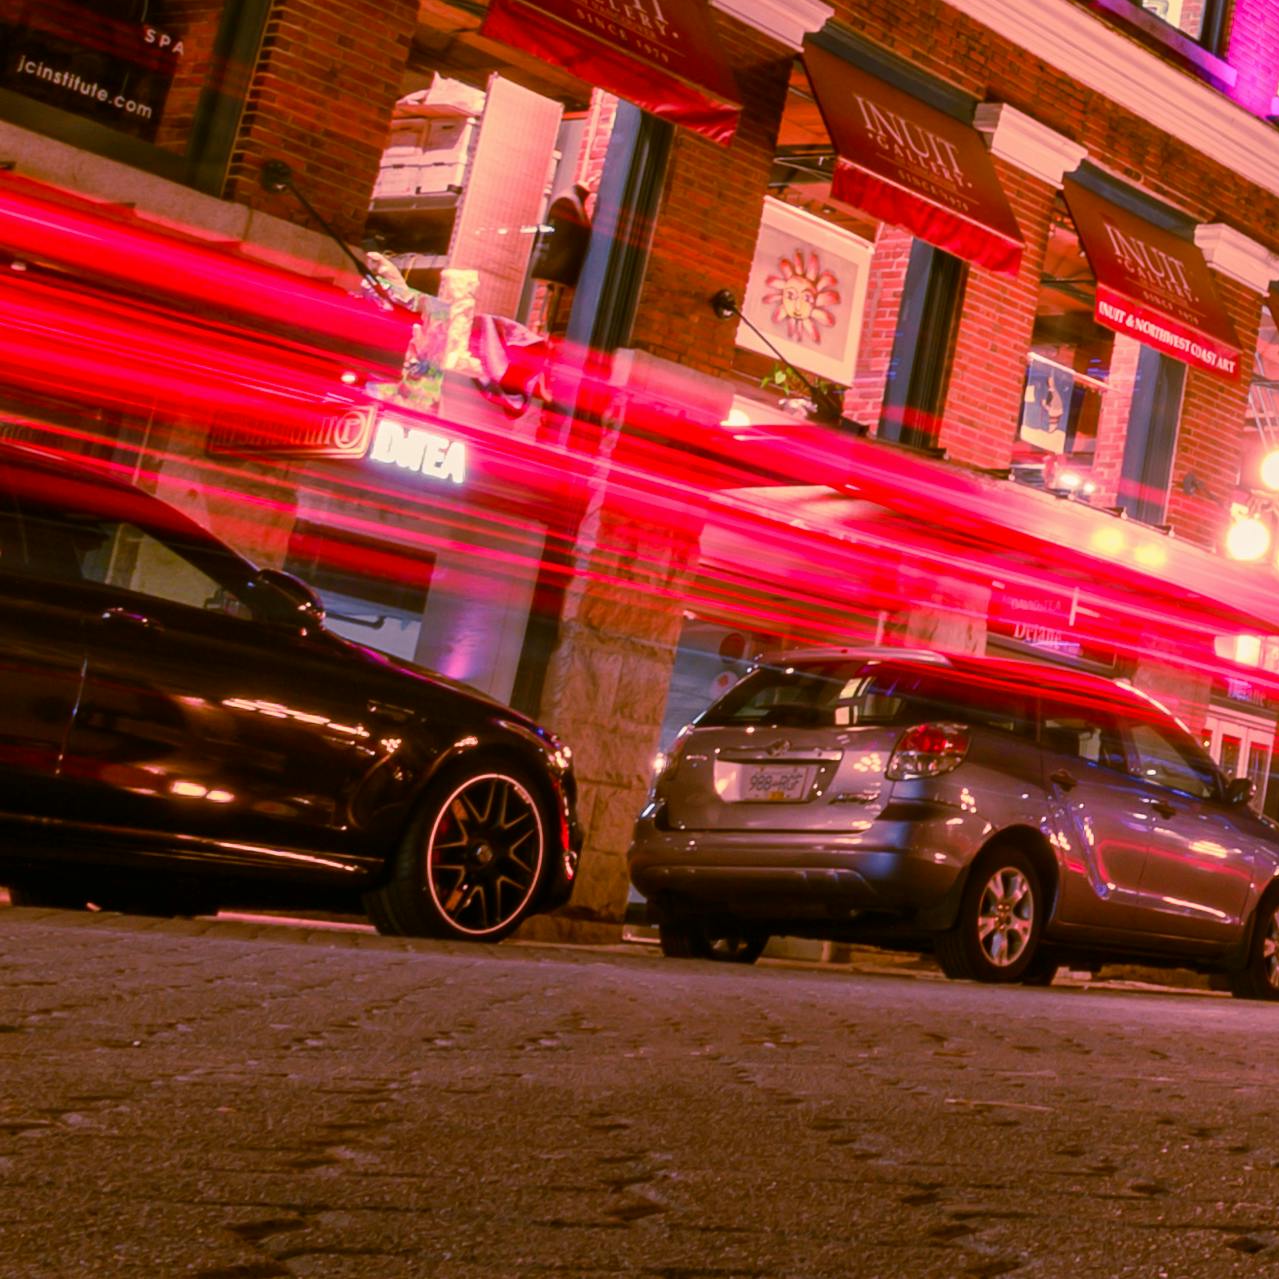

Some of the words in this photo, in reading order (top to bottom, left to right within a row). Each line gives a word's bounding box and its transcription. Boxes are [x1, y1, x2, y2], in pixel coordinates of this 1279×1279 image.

[143, 28, 185, 56] SPA
[575, 7, 628, 40] SINCE
[16, 54, 153, 120] jcinstitute.com
[852, 91, 963, 176] INUIT
[876, 134, 965, 188] GALLERY
[1103, 221, 1193, 292] INUIT
[1098, 300, 1127, 325] INUIT
[1125, 314, 1135, 328] &
[1134, 316, 1192, 352] NORTHWEST
[1190, 339, 1217, 366] COAST
[1215, 354, 1236, 374] ART
